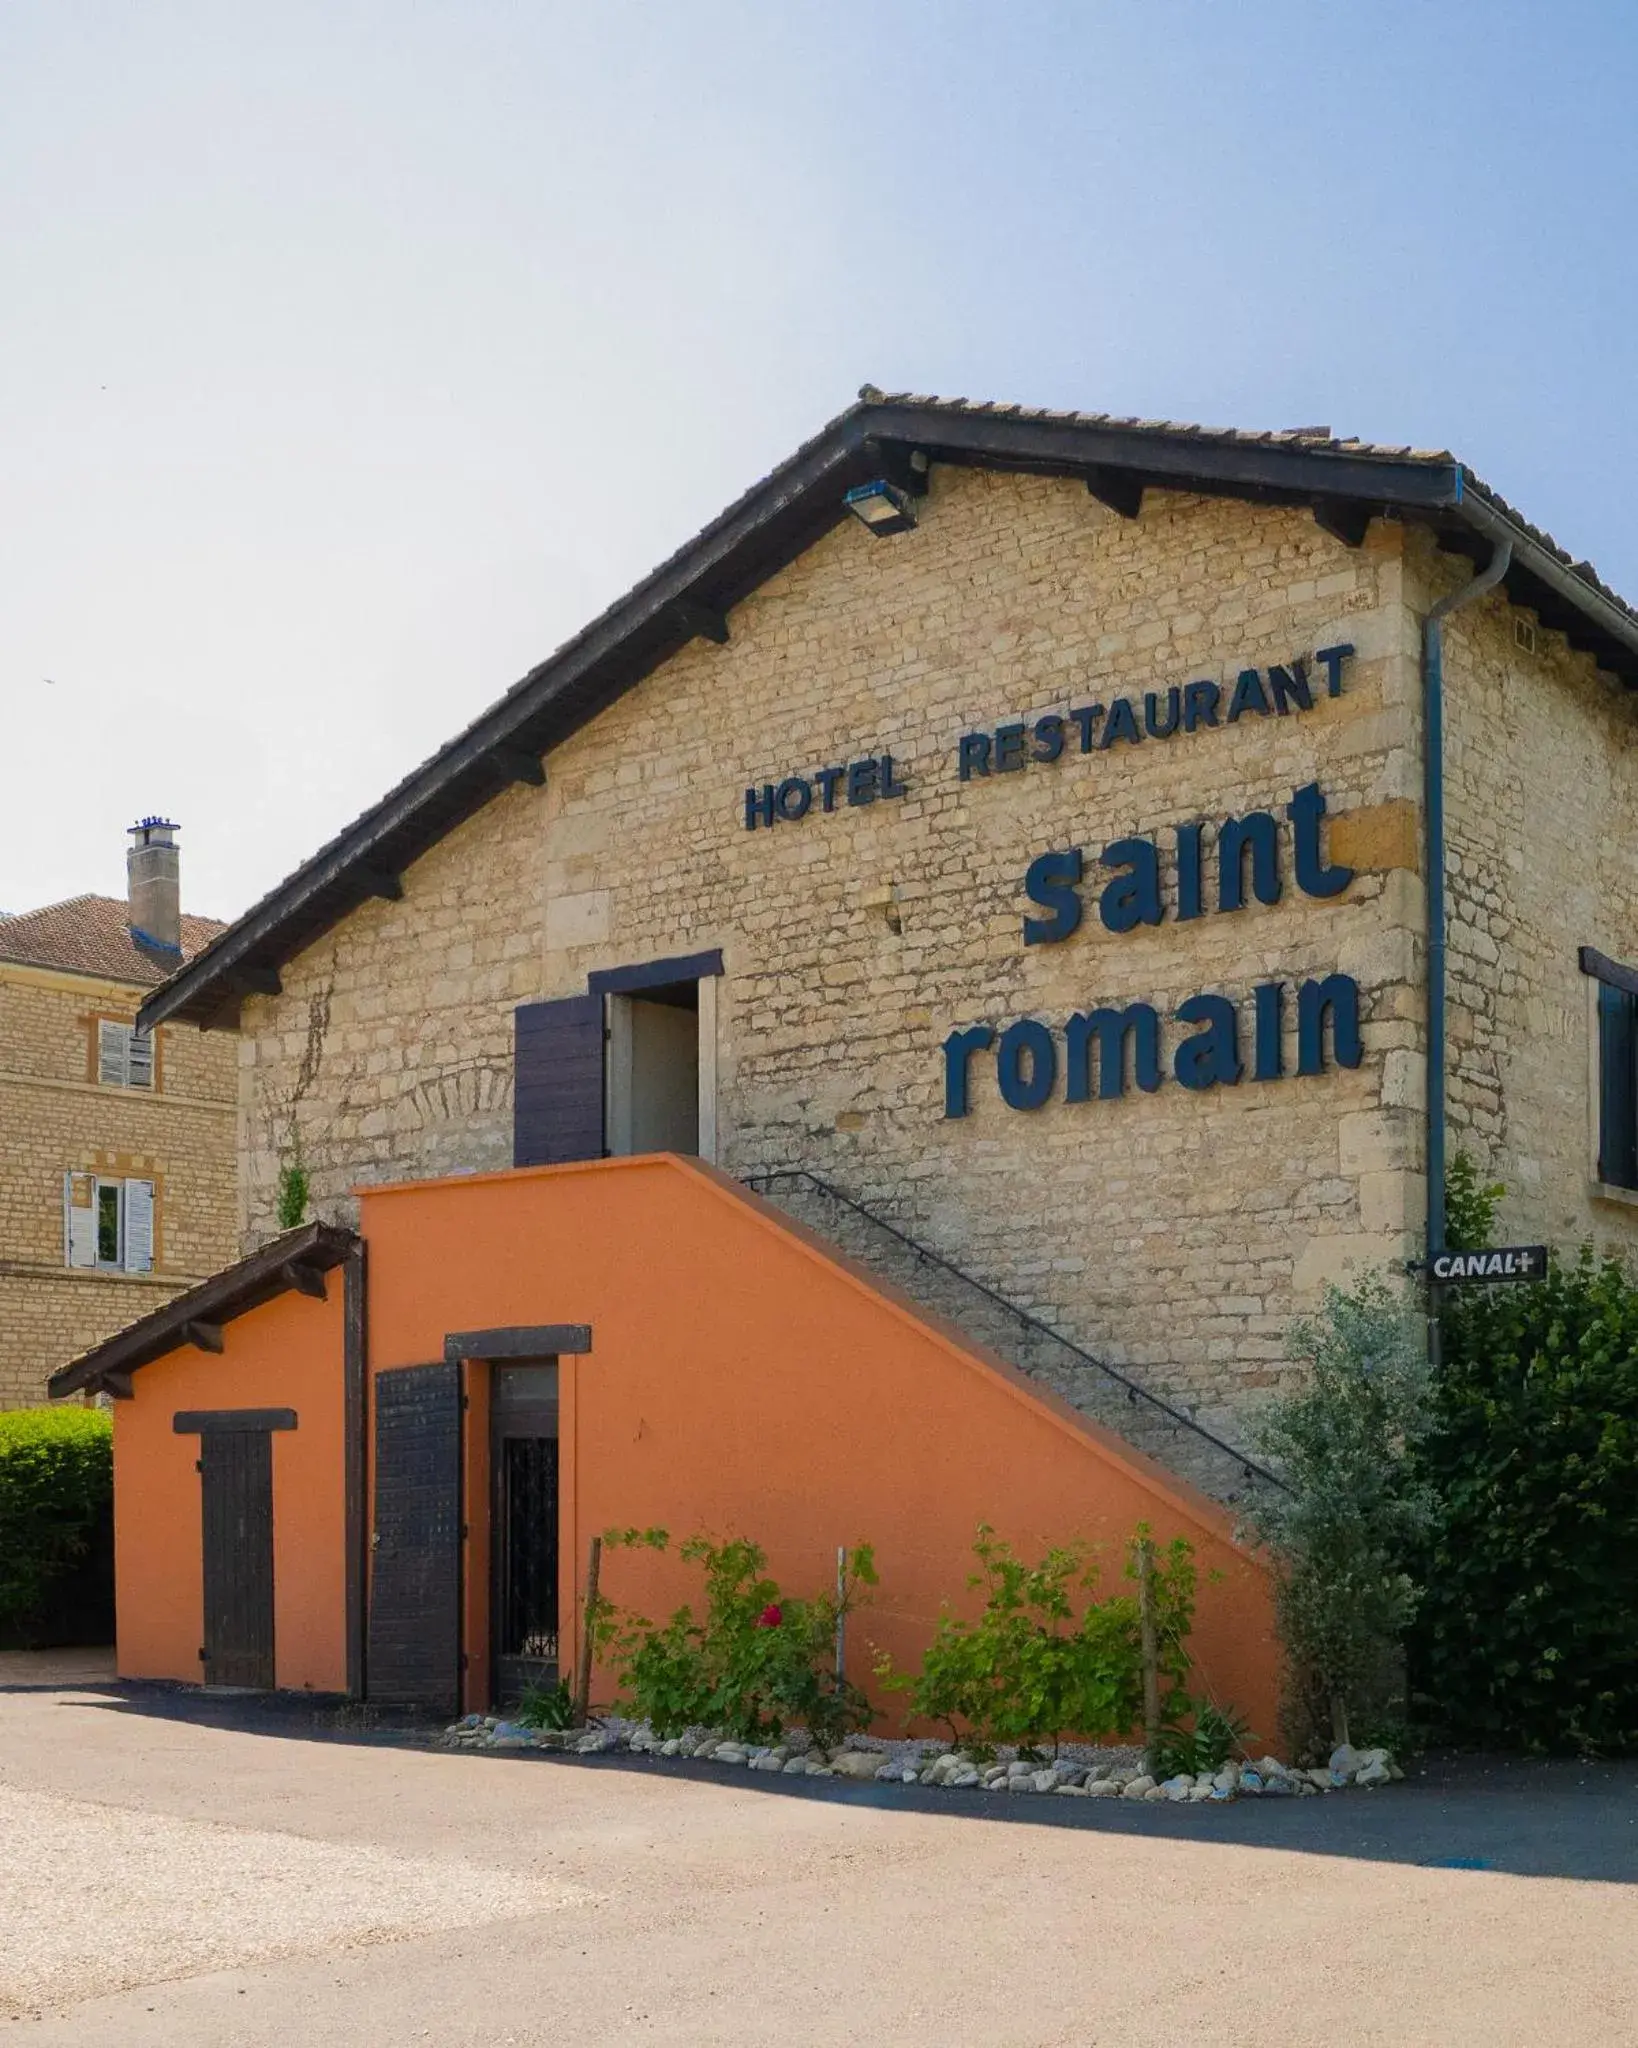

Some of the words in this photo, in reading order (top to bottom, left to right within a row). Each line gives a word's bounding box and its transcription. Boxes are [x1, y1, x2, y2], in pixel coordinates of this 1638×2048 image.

[745, 754, 907, 830] HOTEL
[959, 643, 1355, 781] RESTAURANT
[1023, 782, 1354, 946] saint
[942, 973, 1363, 1120] romain
[1434, 1252, 1534, 1278] CANAL+
